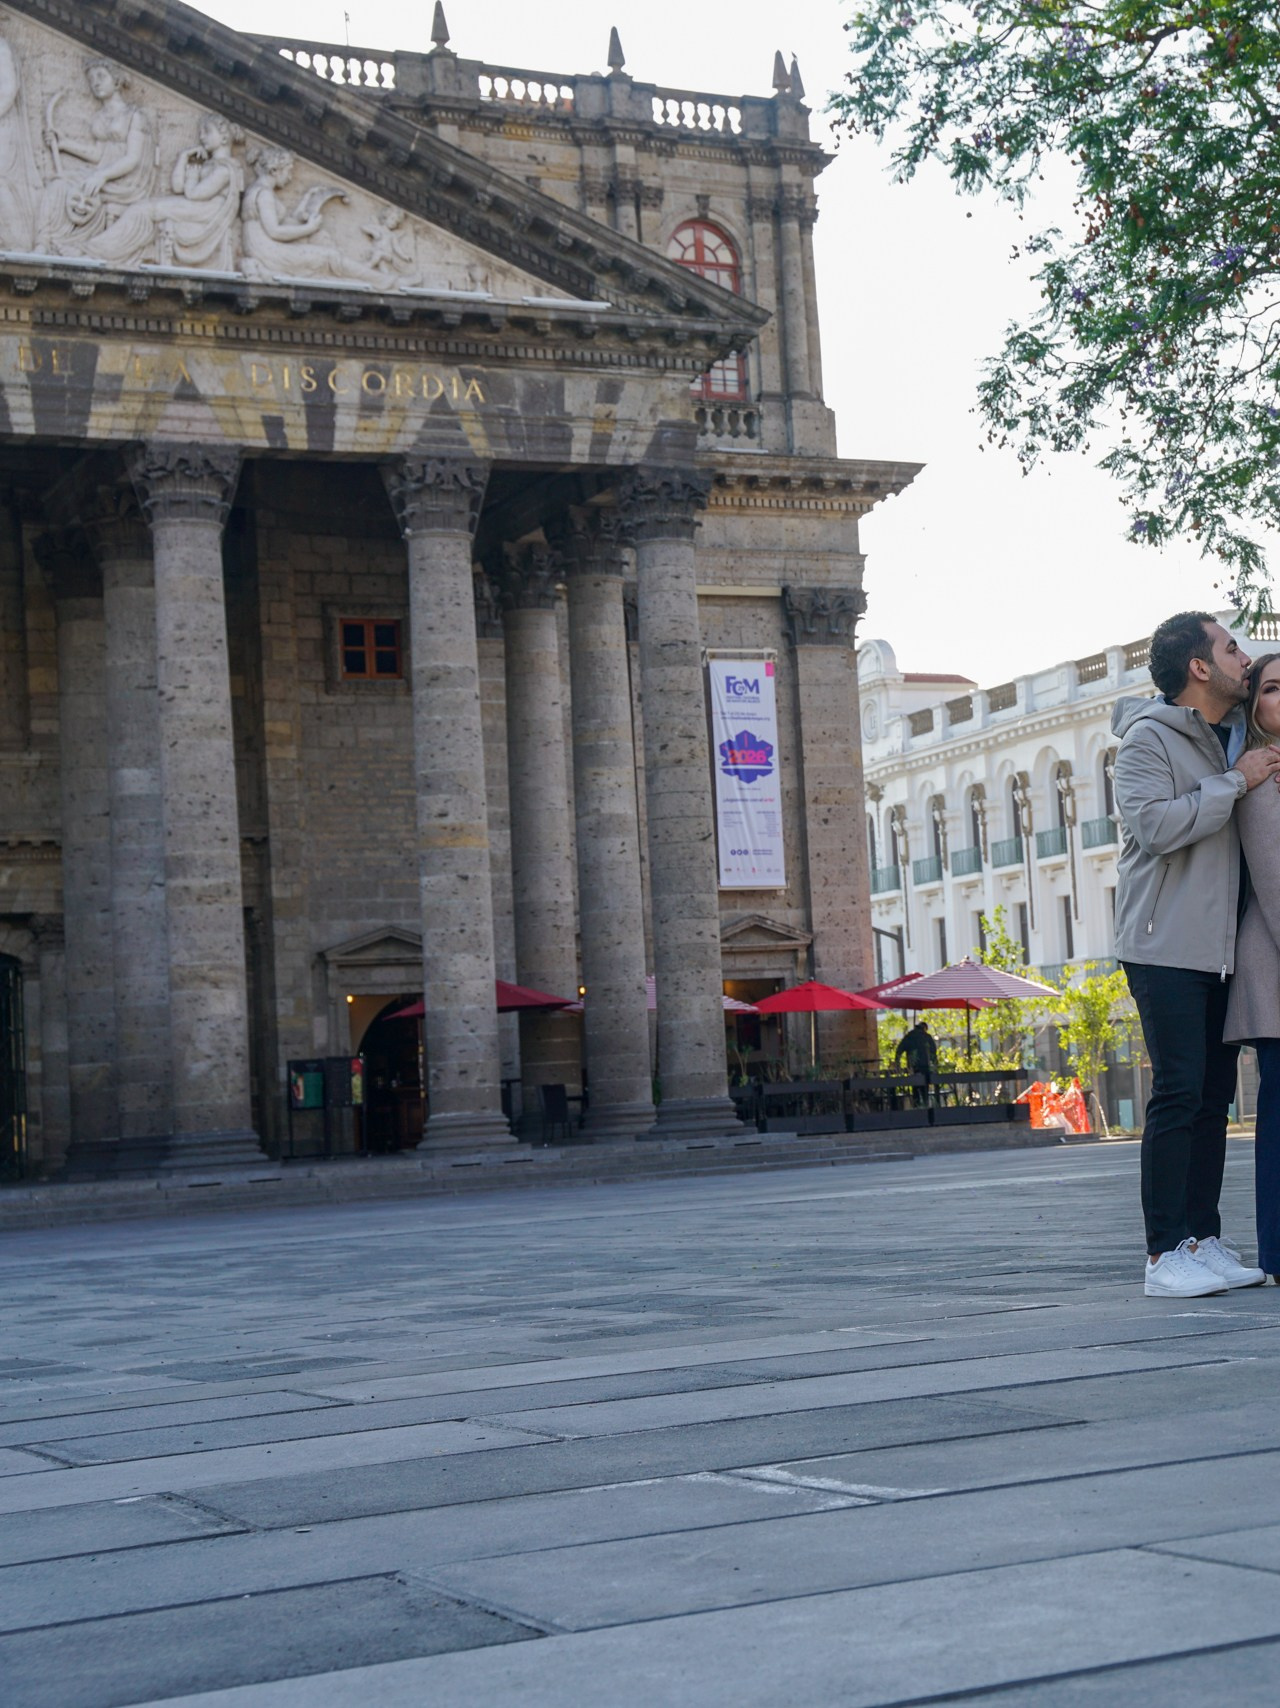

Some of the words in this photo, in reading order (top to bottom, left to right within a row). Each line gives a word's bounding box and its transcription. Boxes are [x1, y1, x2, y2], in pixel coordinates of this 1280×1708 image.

[19, 346, 74, 376] DE
[250, 363, 486, 403] DISCORDIA
[725, 676, 760, 695] FCM
[729, 749, 766, 764] 2026
